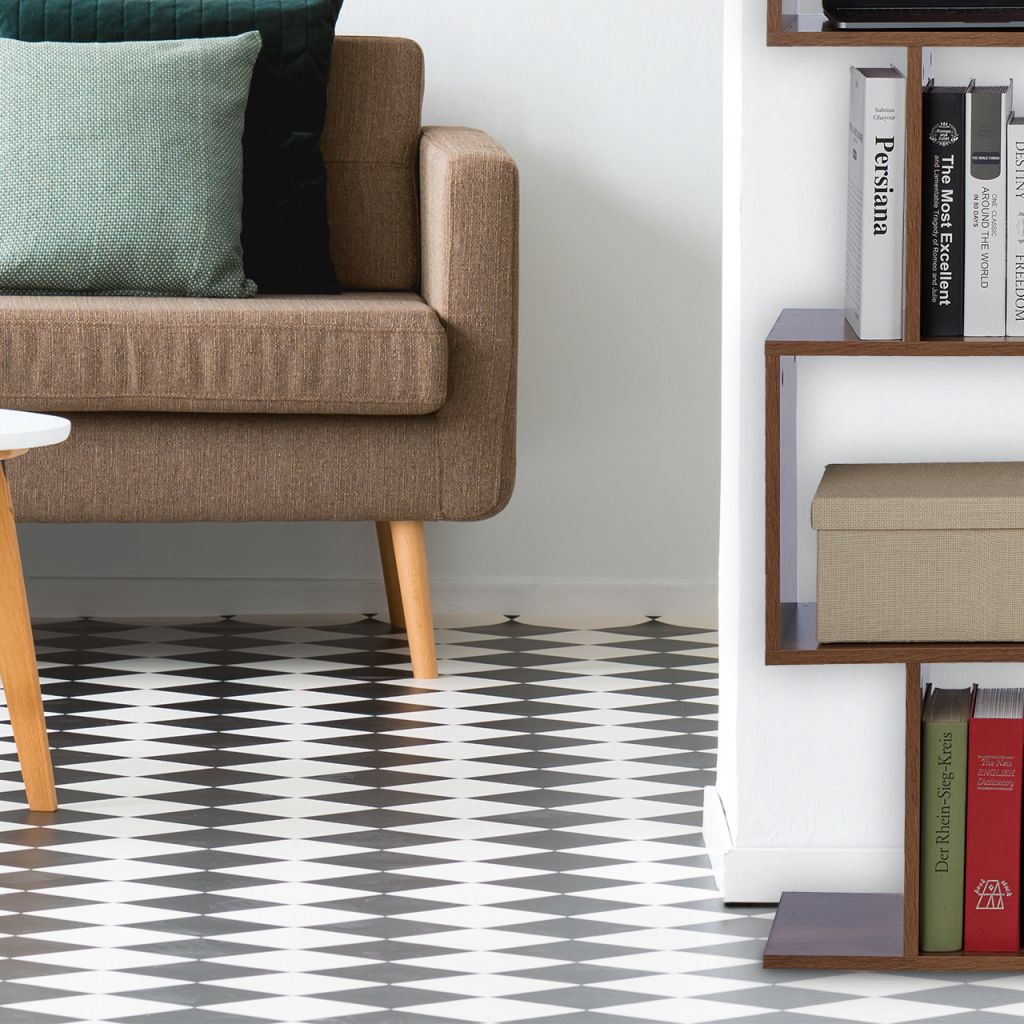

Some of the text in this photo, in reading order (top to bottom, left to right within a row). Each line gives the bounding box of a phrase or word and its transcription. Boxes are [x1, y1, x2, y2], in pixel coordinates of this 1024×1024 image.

[873, 135, 895, 236] Persiana
[932, 210, 940, 238] Tragedy
[939, 154, 954, 306] The Most Excellent
[973, 193, 979, 201] IN
[980, 186, 990, 289] AROUND THE WORLD
[935, 732, 955, 872] Der Rhein-Sieg-Kreis
